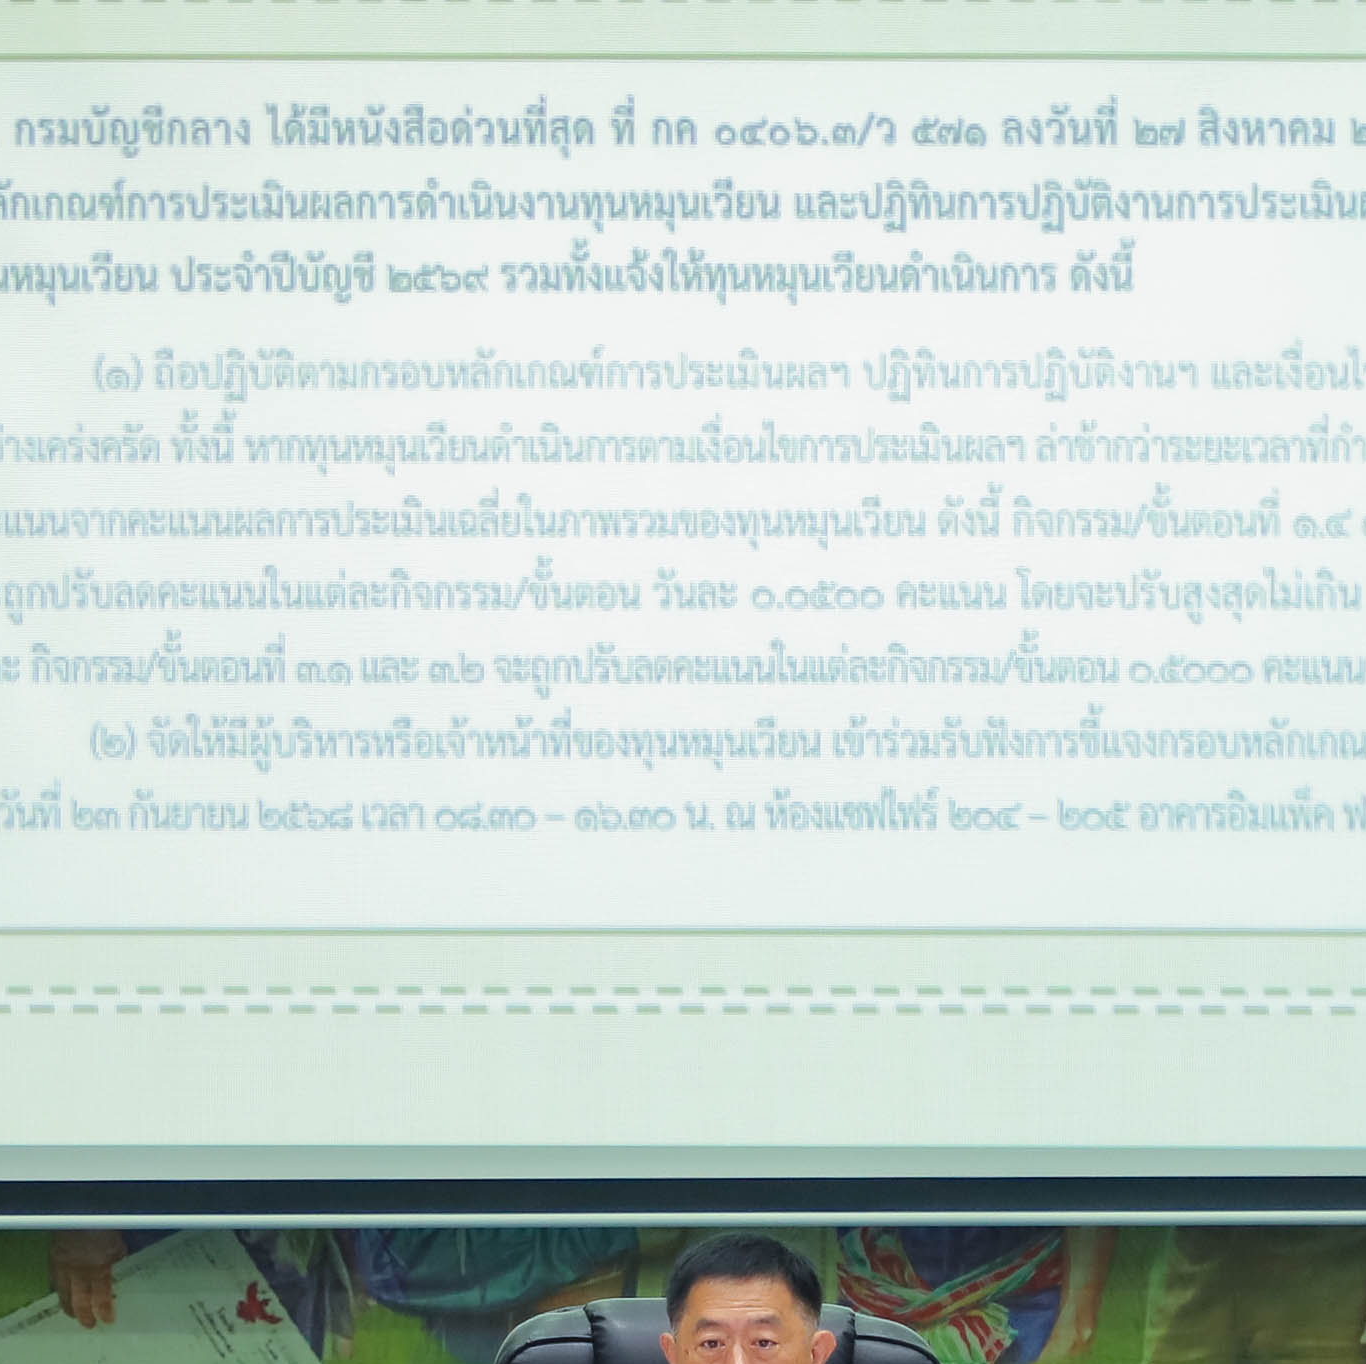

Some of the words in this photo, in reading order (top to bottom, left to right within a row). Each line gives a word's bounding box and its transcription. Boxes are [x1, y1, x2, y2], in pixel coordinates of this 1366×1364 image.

[13, 103, 252, 160] กรมบัญชีกลาง
[263, 94, 596, 160] ได้มีหนังสือด่วนที่สุด
[609, 94, 637, 147] ที่
[651, 115, 698, 147] กค
[910, 116, 989, 148] ๕๗๑
[1001, 94, 1119, 147] ลงวันที่
[1132, 116, 1187, 148] ๒๗
[1197, 103, 1336, 147] สิงหาคม
[169, 248, 377, 305] ประจำปีบัญชี
[386, 261, 490, 294] ๒๕๖๙
[1068, 237, 1137, 293] ดังนี้
